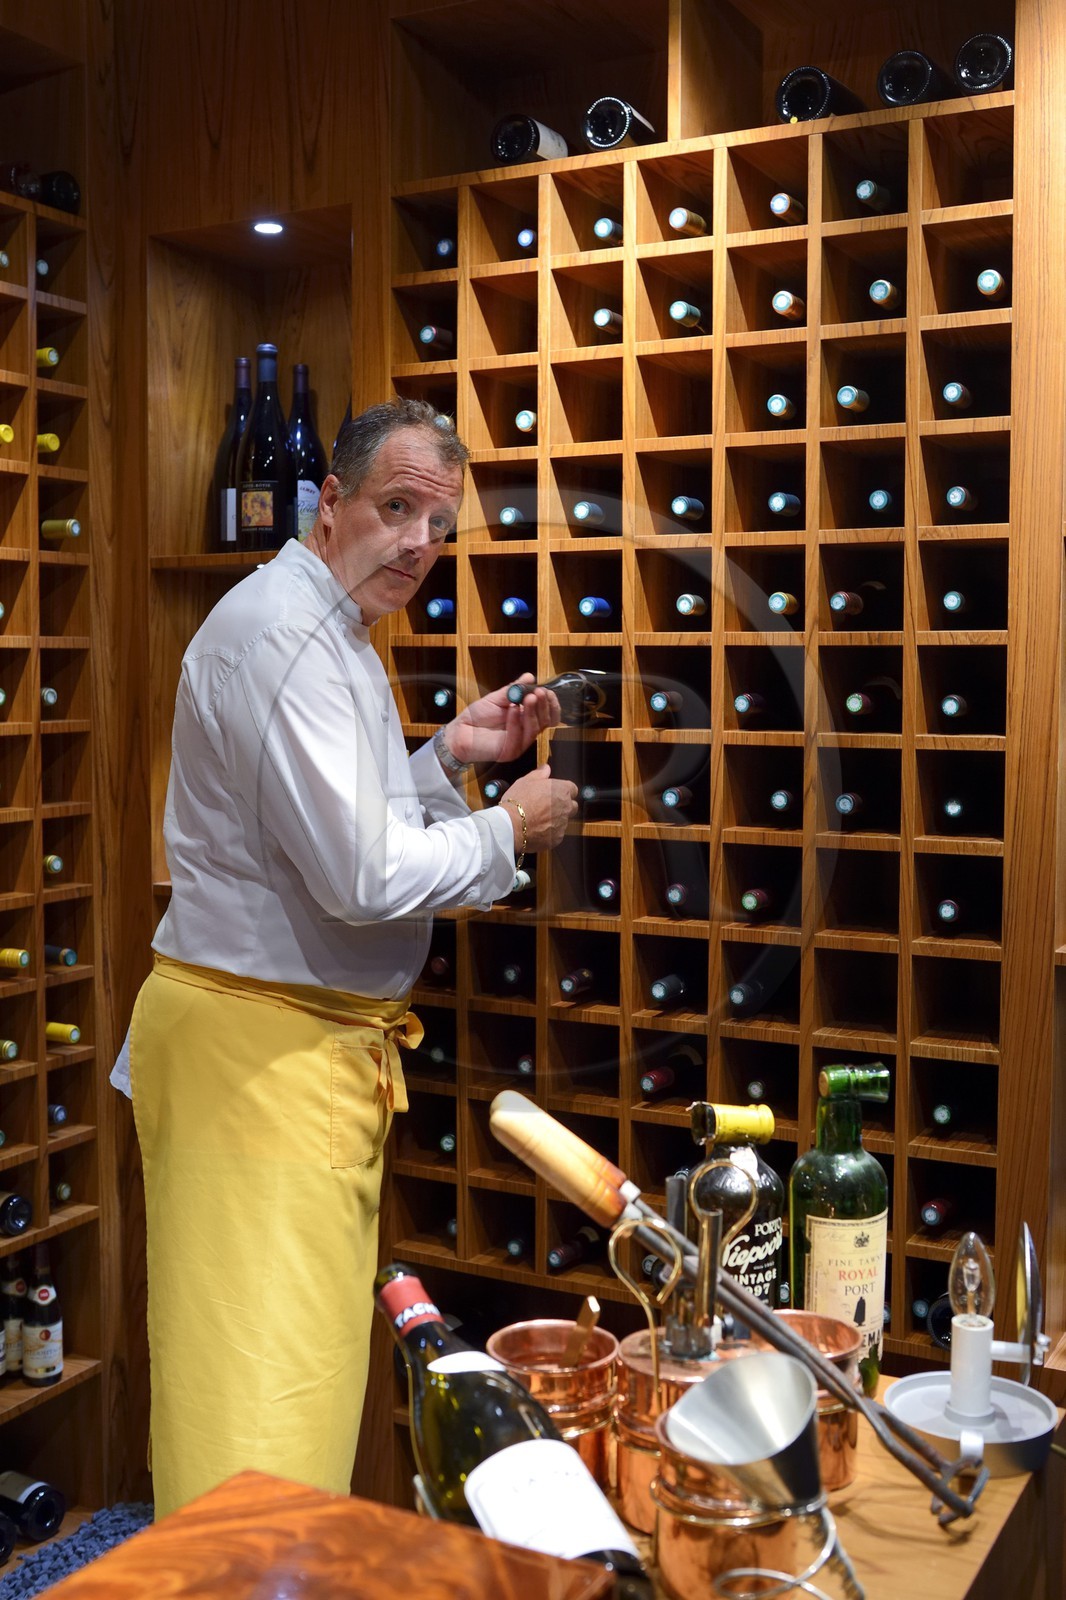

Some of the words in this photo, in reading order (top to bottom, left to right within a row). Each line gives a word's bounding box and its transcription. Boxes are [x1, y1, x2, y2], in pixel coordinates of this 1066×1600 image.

[754, 1216, 782, 1237] PORTO
[828, 1258, 852, 1267] FINE
[838, 1266, 878, 1281] ROYAL
[744, 1282, 770, 1297] 997
[844, 1282, 876, 1296] PORT
